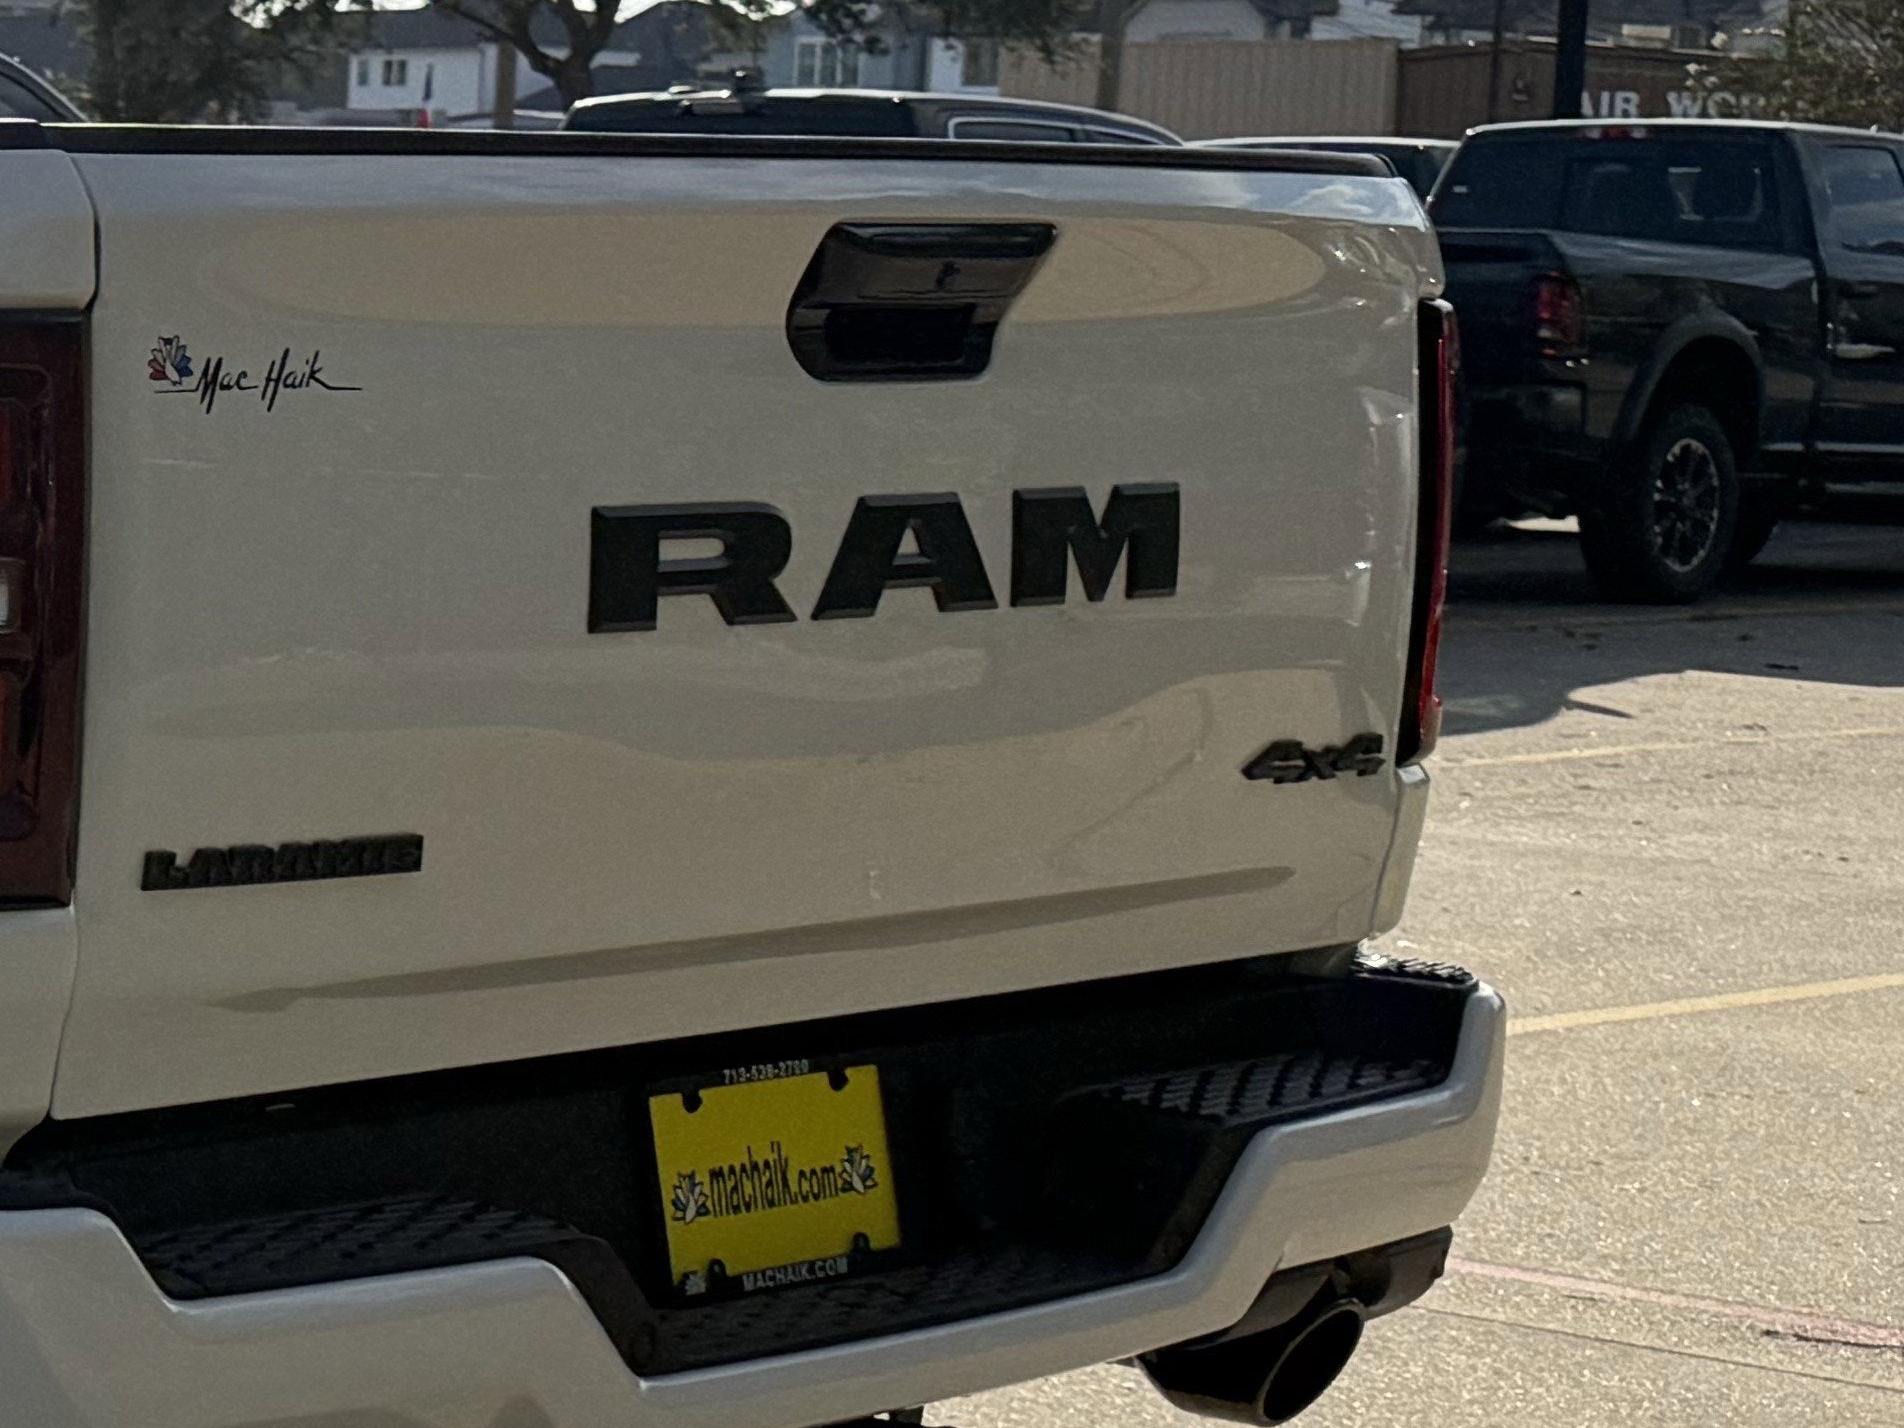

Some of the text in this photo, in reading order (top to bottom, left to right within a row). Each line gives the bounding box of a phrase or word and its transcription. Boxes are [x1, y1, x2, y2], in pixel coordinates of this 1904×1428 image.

[178, 347, 344, 415] Mac Haik
[587, 482, 1181, 634] RAM
[140, 832, 425, 892] LARAMIE
[708, 1140, 840, 1218] machaik.com
[741, 1255, 849, 1293] MACHAIK.COM
